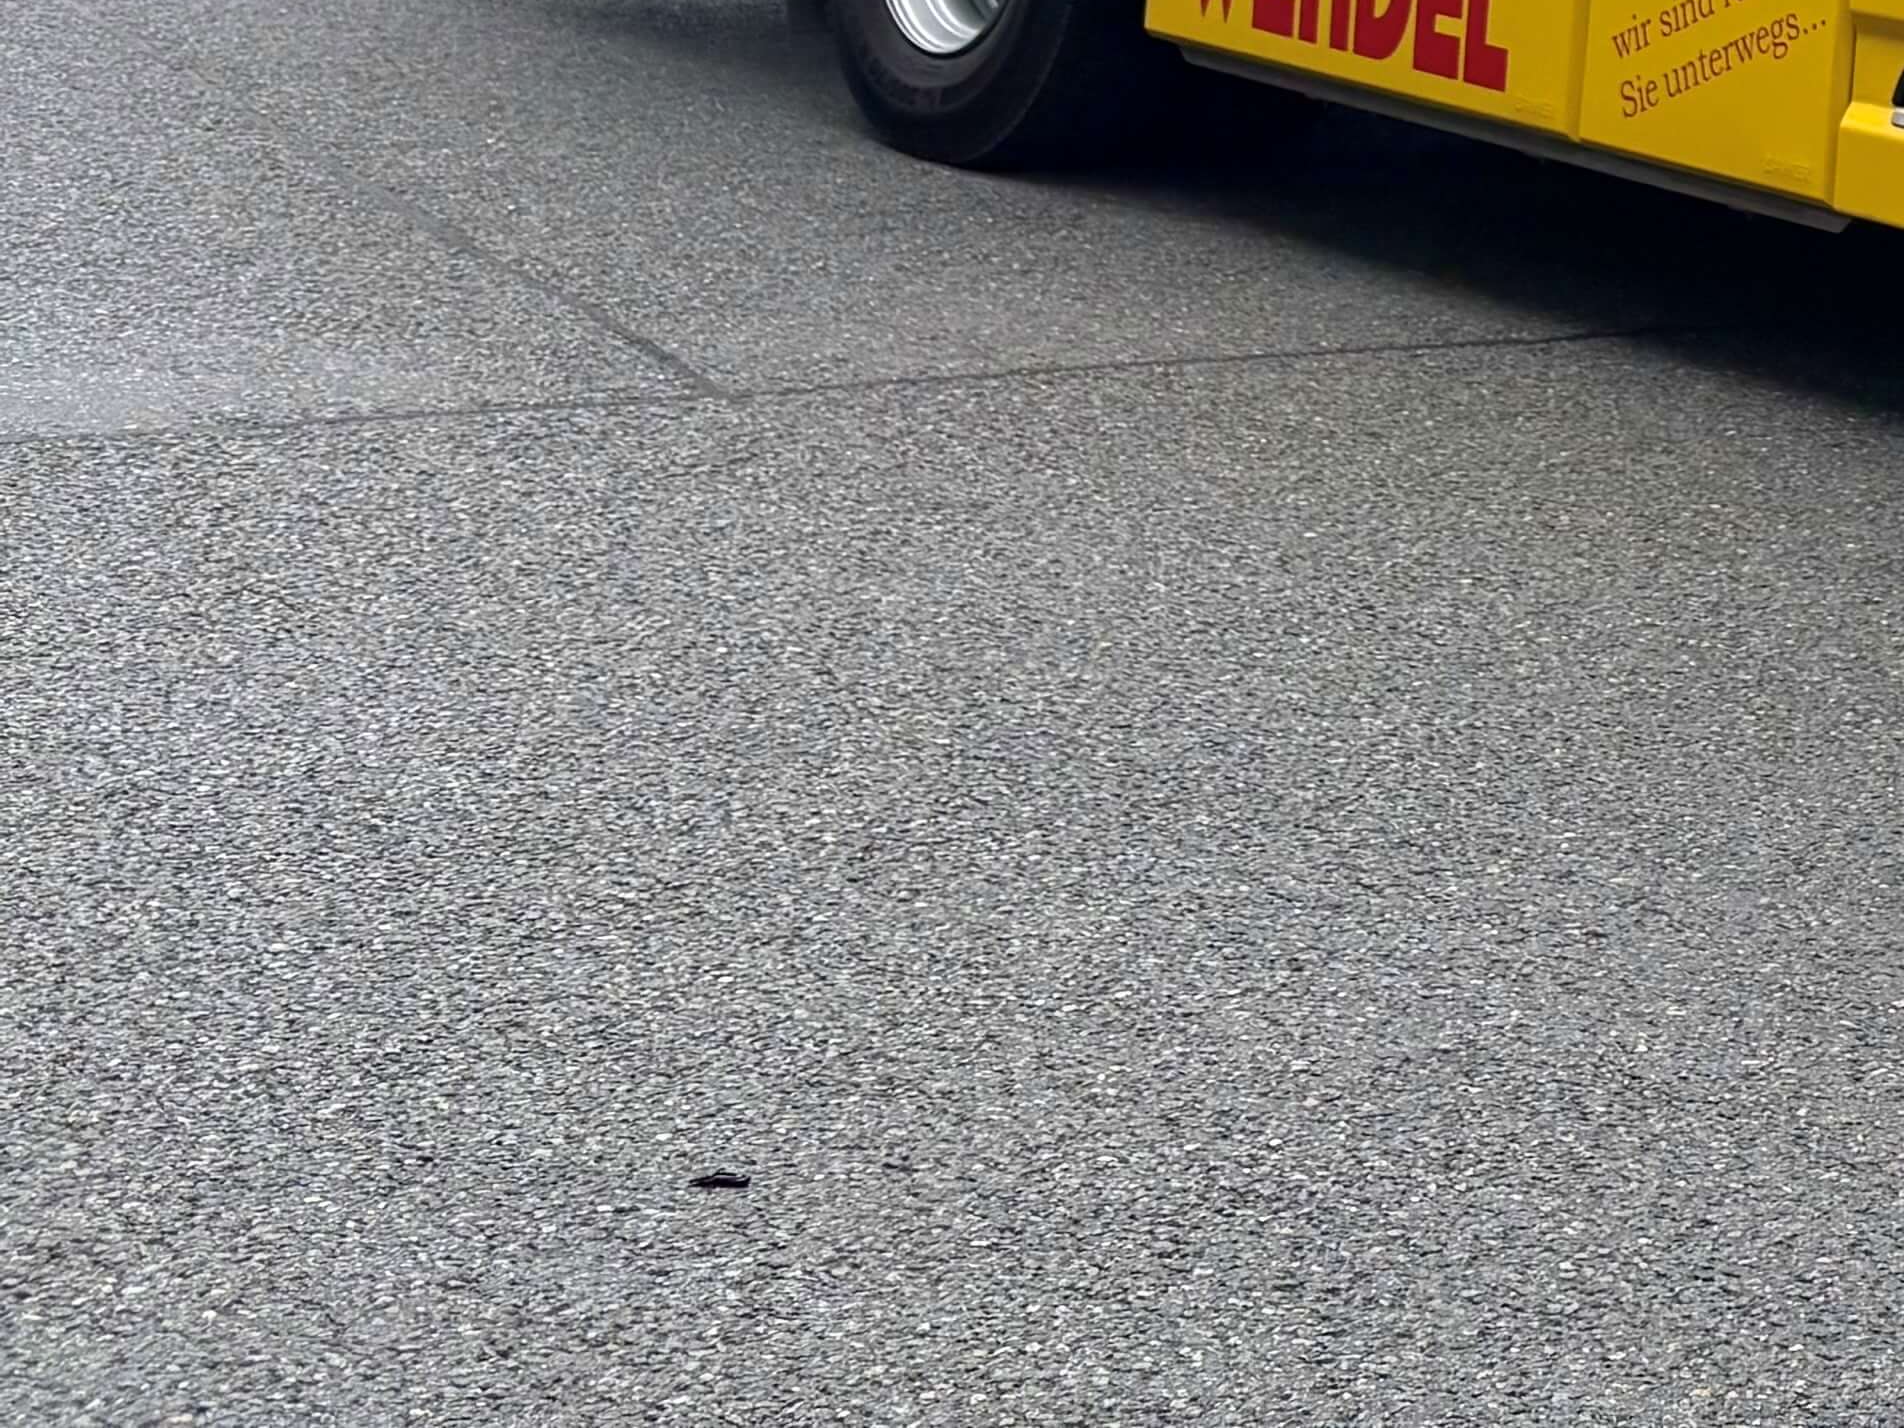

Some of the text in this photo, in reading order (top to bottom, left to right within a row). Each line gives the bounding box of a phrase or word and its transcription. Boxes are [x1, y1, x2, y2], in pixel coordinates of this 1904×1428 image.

[1611, 13, 1652, 59] wir
[1619, 12, 1827, 119] Sie unterwegs...
